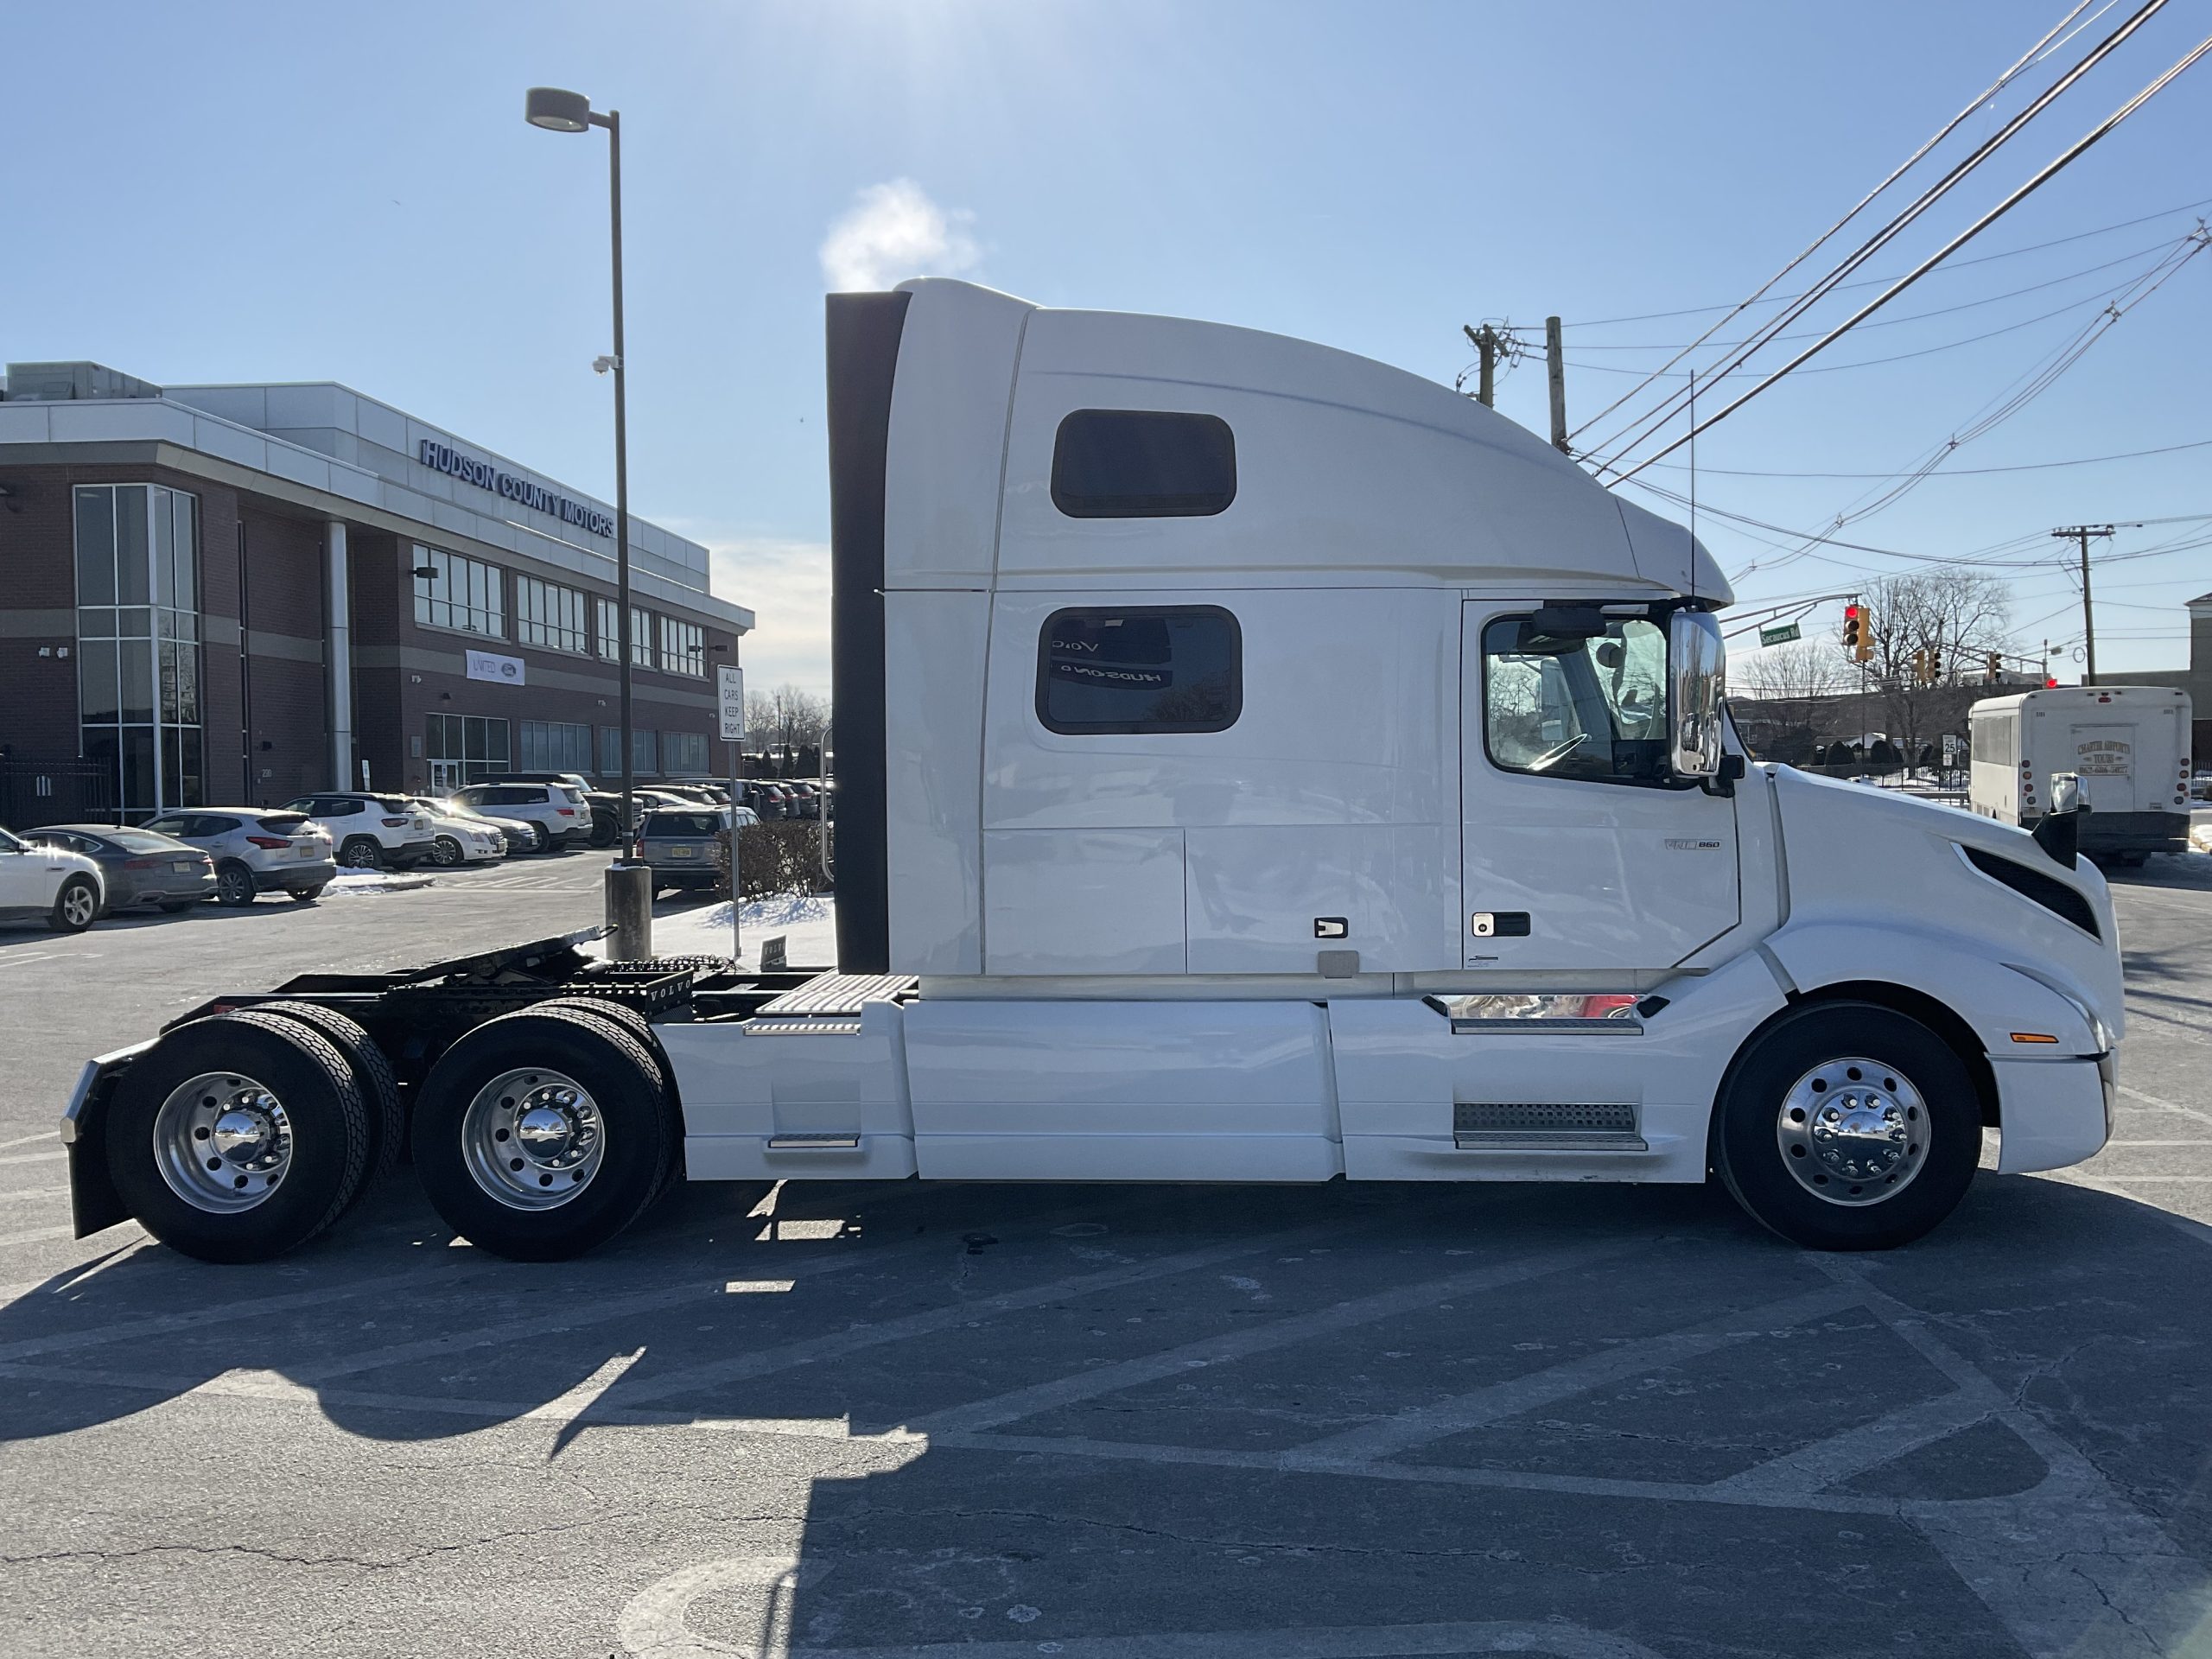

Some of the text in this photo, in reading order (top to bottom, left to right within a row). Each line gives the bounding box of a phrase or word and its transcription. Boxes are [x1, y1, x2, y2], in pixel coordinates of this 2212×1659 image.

[421, 439, 614, 538] HUDSON COUNTY MOTORS
[1762, 626, 1799, 645] Secaucus Rd
[726, 672, 736, 683] ALL
[724, 689, 738, 701] CARS
[725, 706, 739, 717] KEEP
[724, 722, 741, 734] RIGHT
[1944, 743, 1955, 753] 25
[2093, 753, 2114, 764] TOURS
[651, 980, 690, 1001] VOLVO
